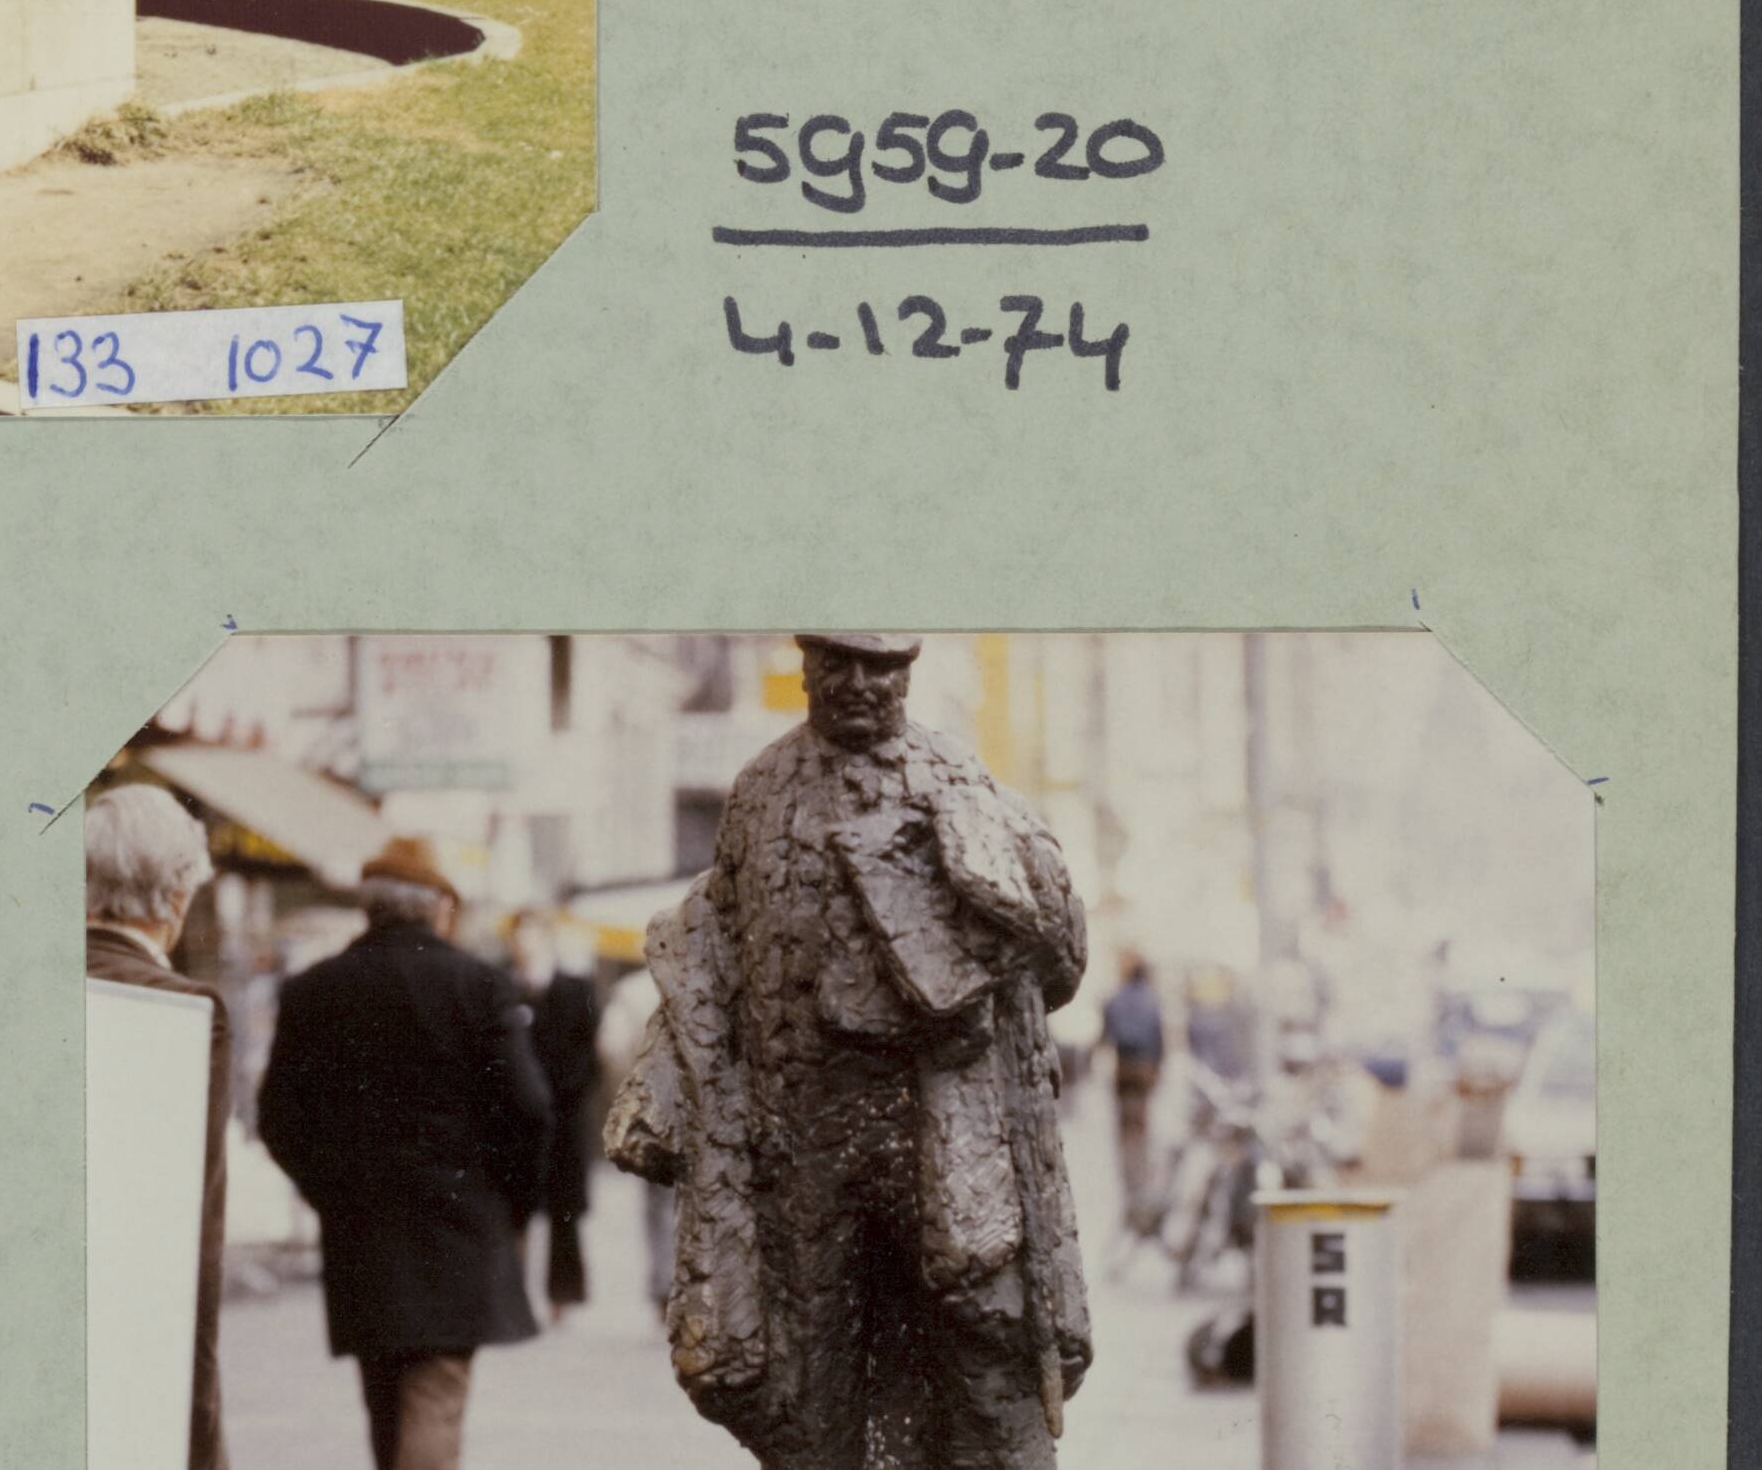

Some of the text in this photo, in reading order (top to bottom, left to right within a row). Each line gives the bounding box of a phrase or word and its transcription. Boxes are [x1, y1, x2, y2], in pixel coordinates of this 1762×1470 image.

[733, 109, 1166, 214] 5959-20
[27, 313, 383, 398] 133 1027
[723, 295, 1130, 392] 4-12-74
